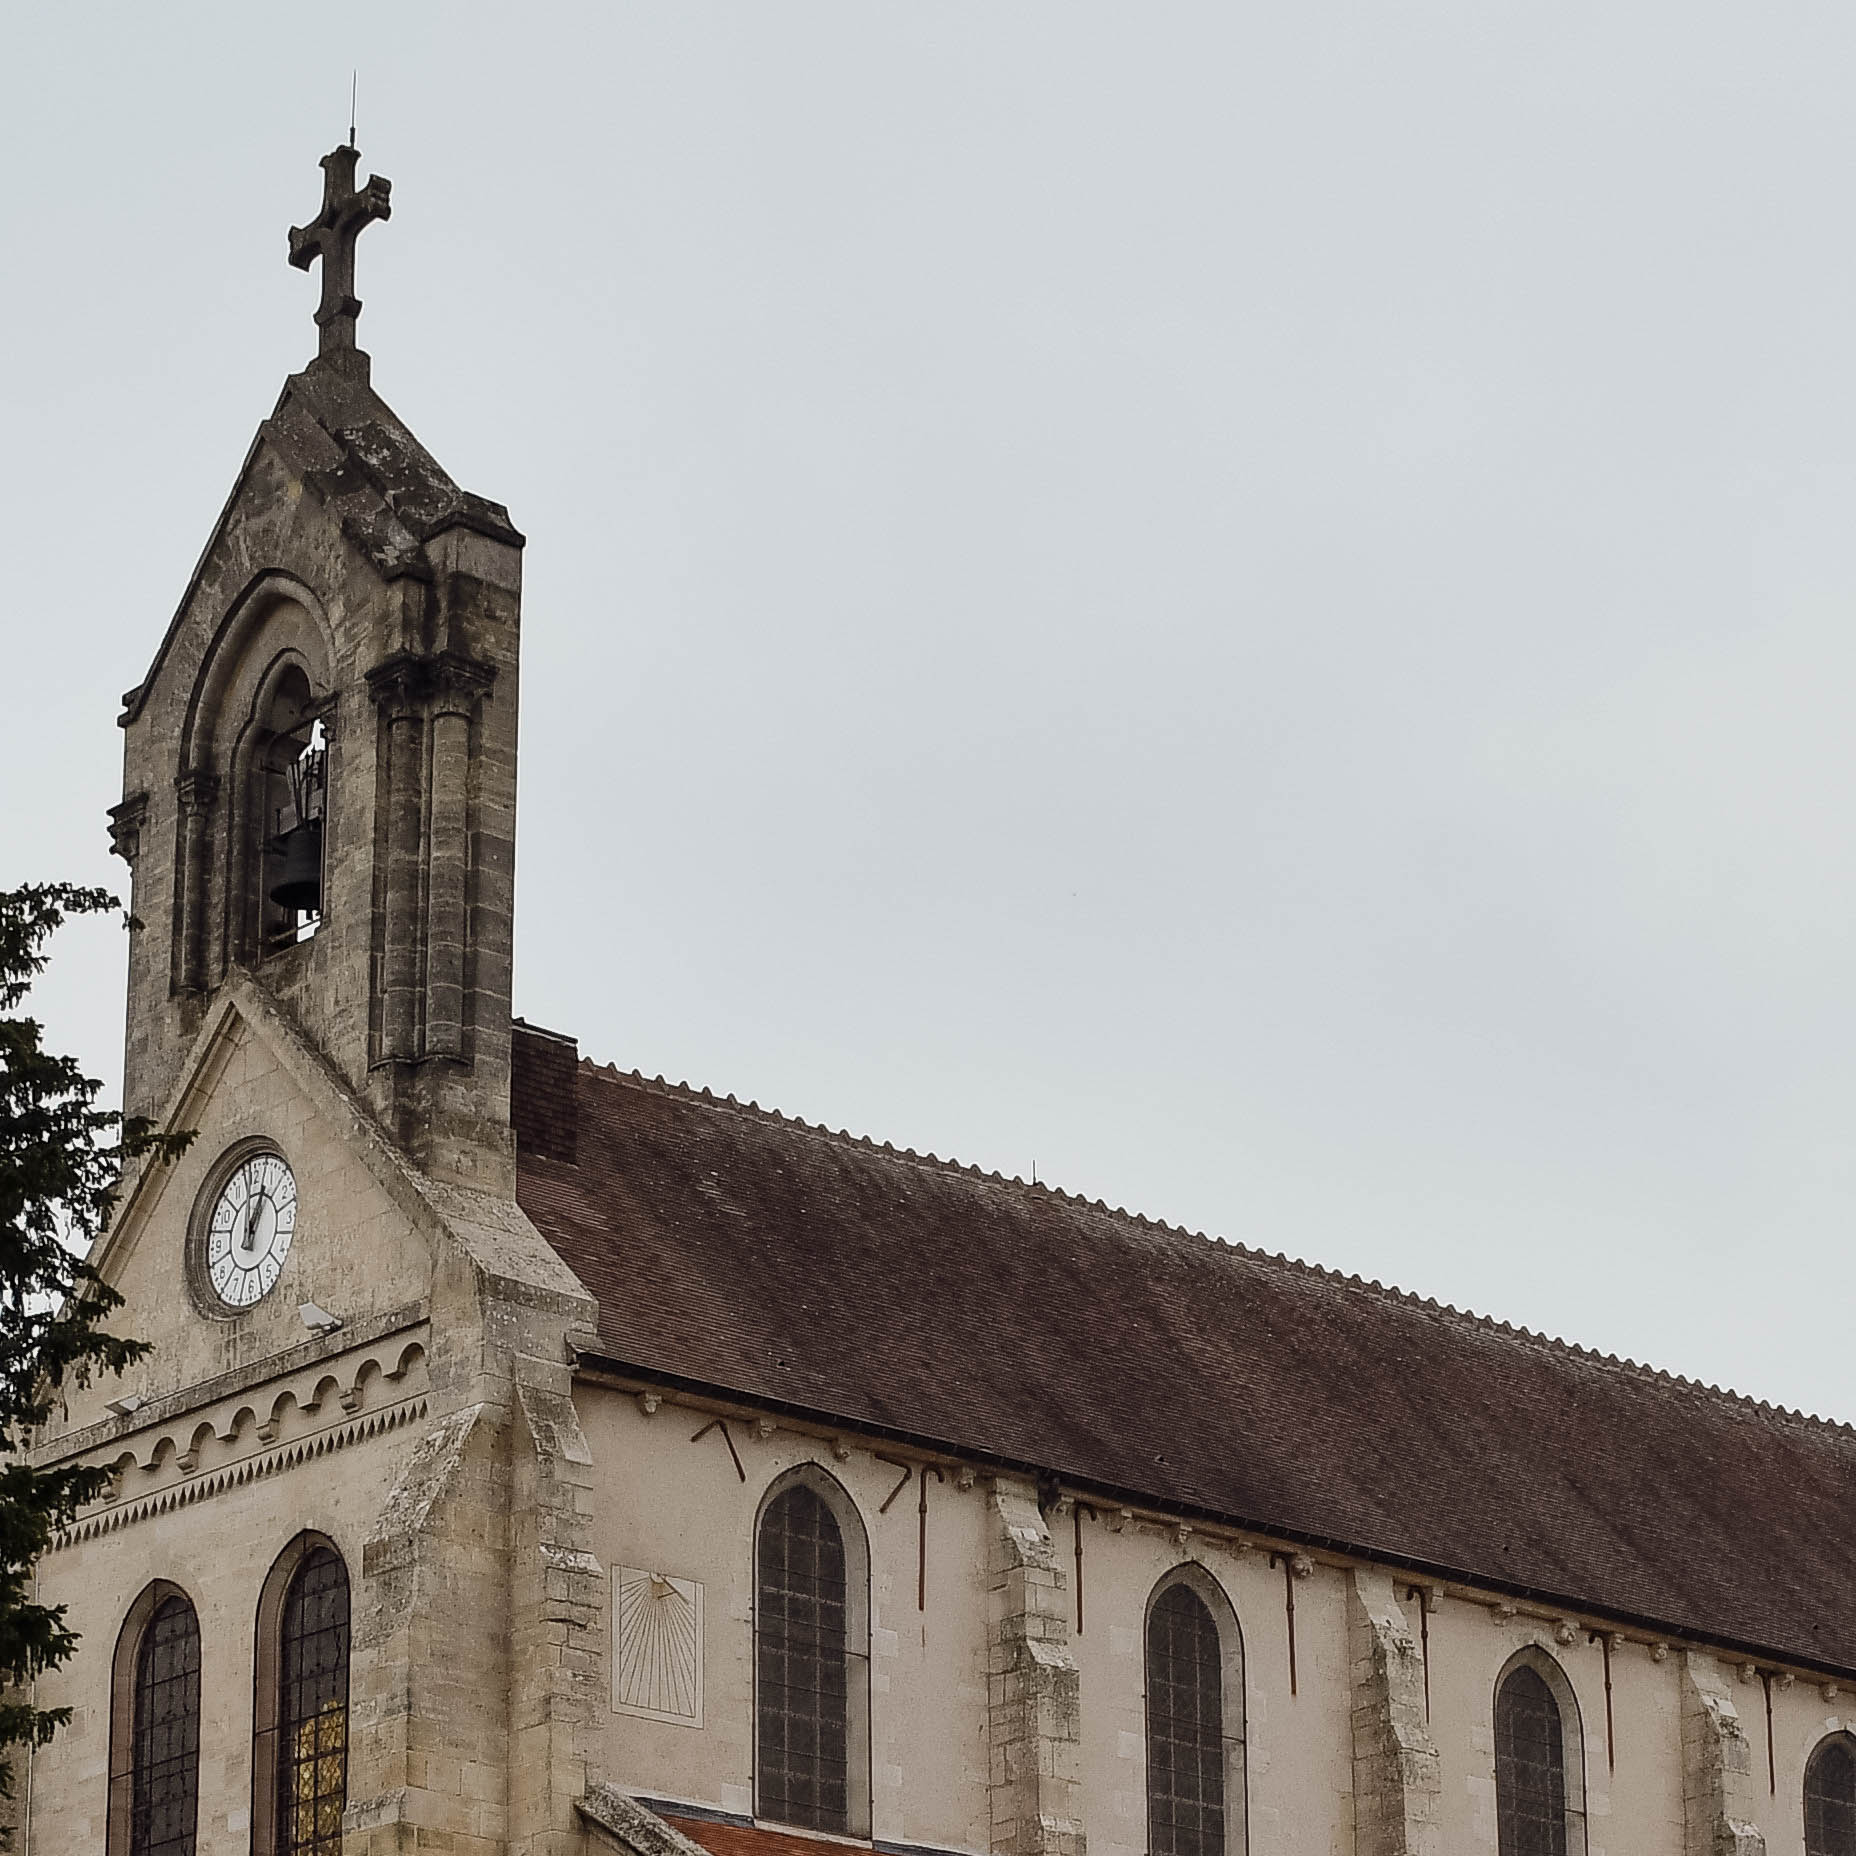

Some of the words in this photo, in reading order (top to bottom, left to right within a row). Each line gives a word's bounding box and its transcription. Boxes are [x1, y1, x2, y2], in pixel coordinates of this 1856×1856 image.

[281, 1185, 288, 1200] 2
[220, 1210, 231, 1224] 10
[285, 1210, 292, 1224] 3
[215, 1240, 222, 1254] 9
[219, 1266, 225, 1279] 8
[265, 1264, 272, 1279] 5
[233, 1278, 239, 1293] 7
[248, 1280, 255, 1294] 6
